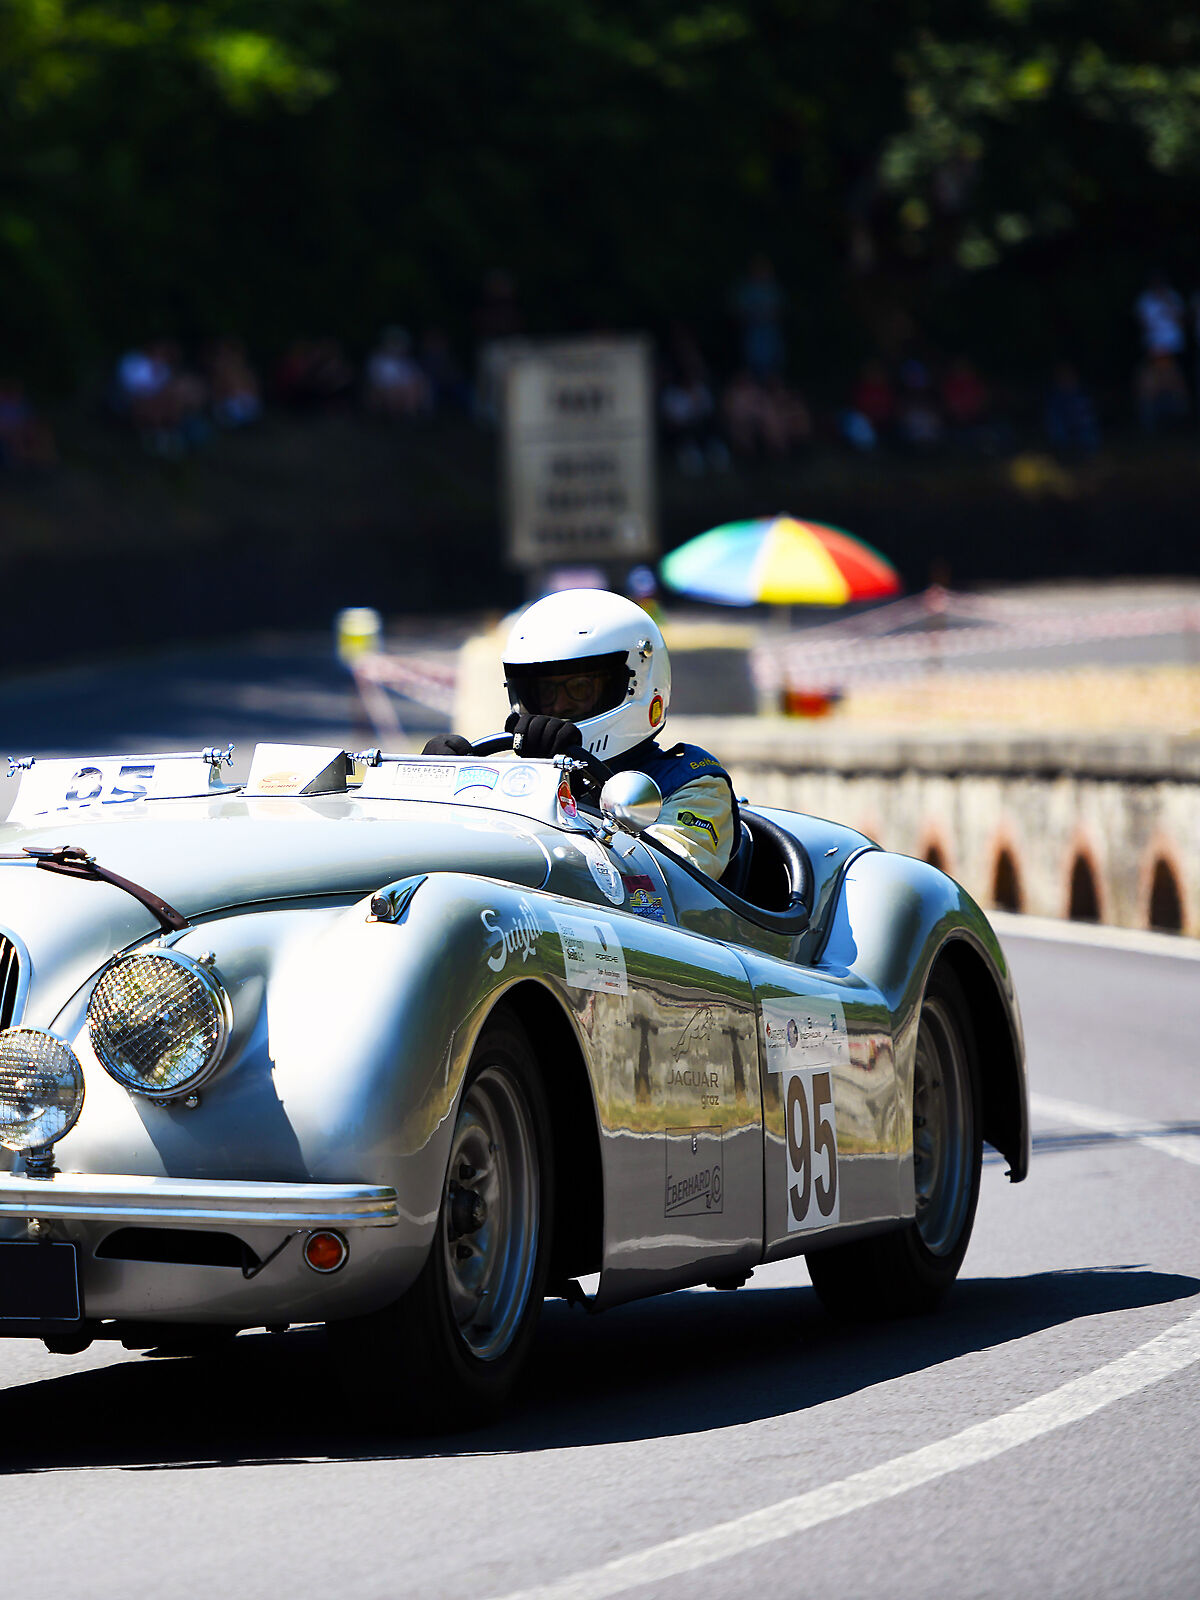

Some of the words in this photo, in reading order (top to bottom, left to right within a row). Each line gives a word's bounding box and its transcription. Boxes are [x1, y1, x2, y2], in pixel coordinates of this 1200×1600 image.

[667, 1069, 719, 1088] JAGUAR
[787, 1071, 837, 1222] 95
[666, 1169, 710, 1207] EBERHARD
